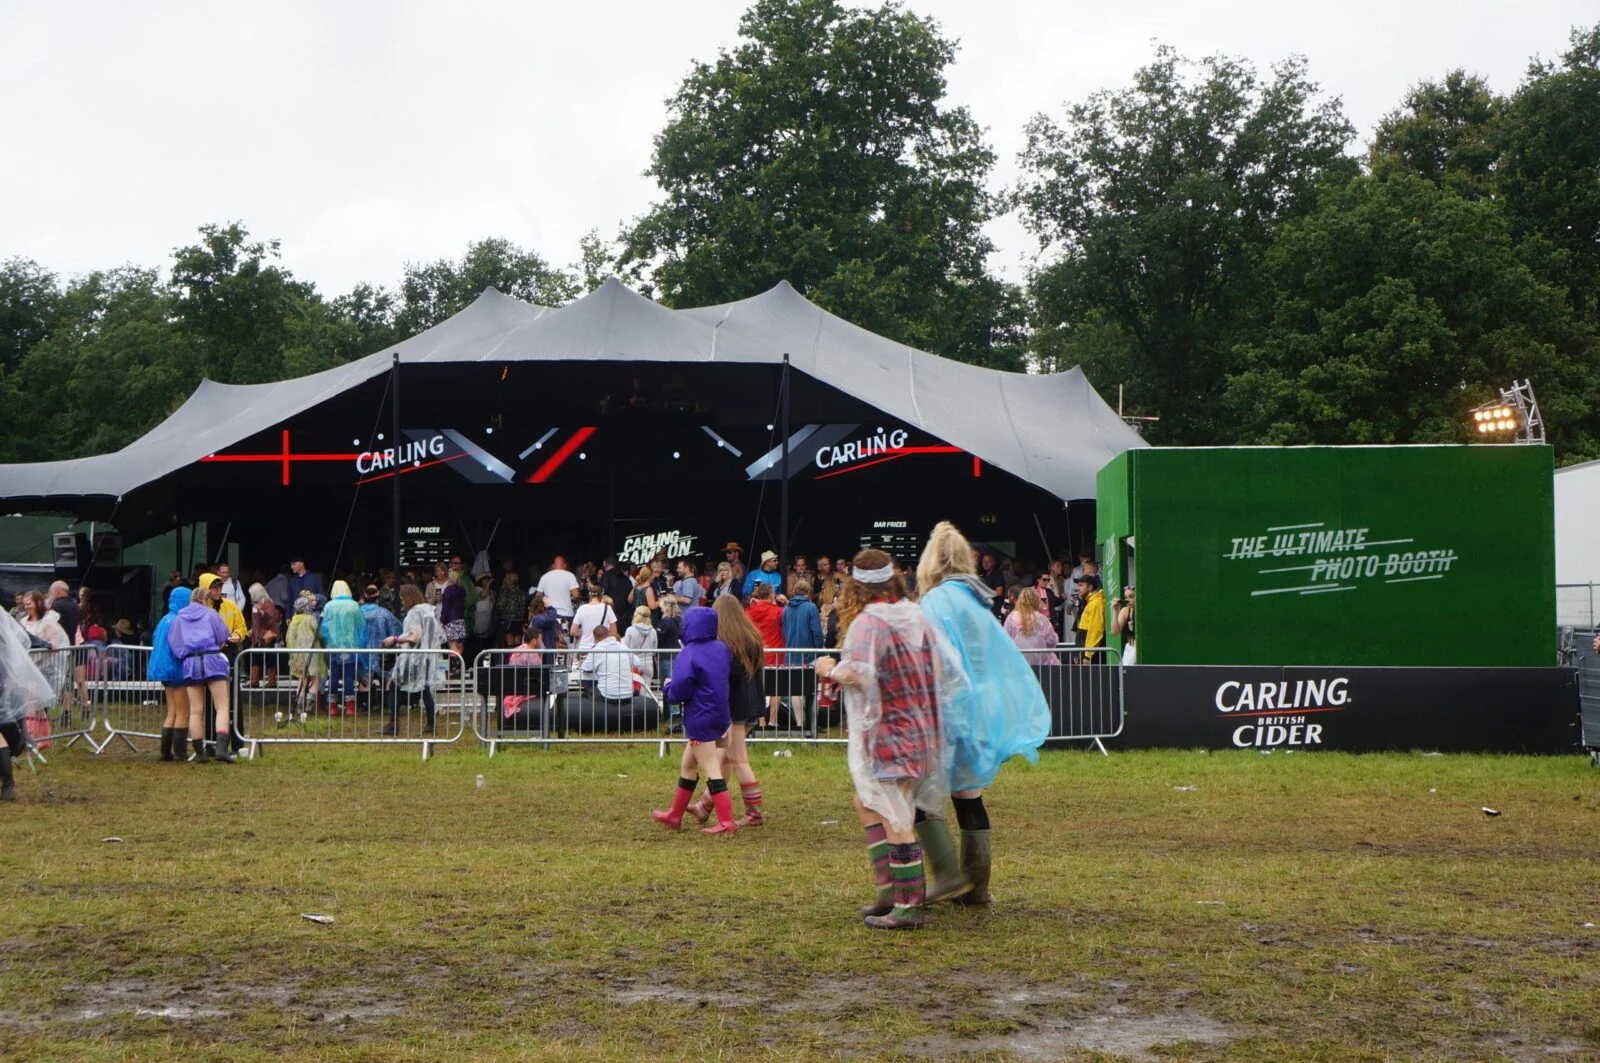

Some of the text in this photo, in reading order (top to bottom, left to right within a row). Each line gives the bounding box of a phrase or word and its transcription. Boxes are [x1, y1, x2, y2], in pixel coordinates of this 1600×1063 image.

[356, 435, 444, 474] CARLING
[815, 429, 905, 469] CARLING
[624, 530, 680, 553] CARLING
[667, 540, 691, 559] ON
[1231, 528, 1369, 560] THE ULTIMATE
[1311, 549, 1454, 581] PHOTO BOOTH
[1215, 677, 1349, 713] CARLING
[1232, 724, 1322, 747] CIDER
[1258, 715, 1305, 726] BRITISH
